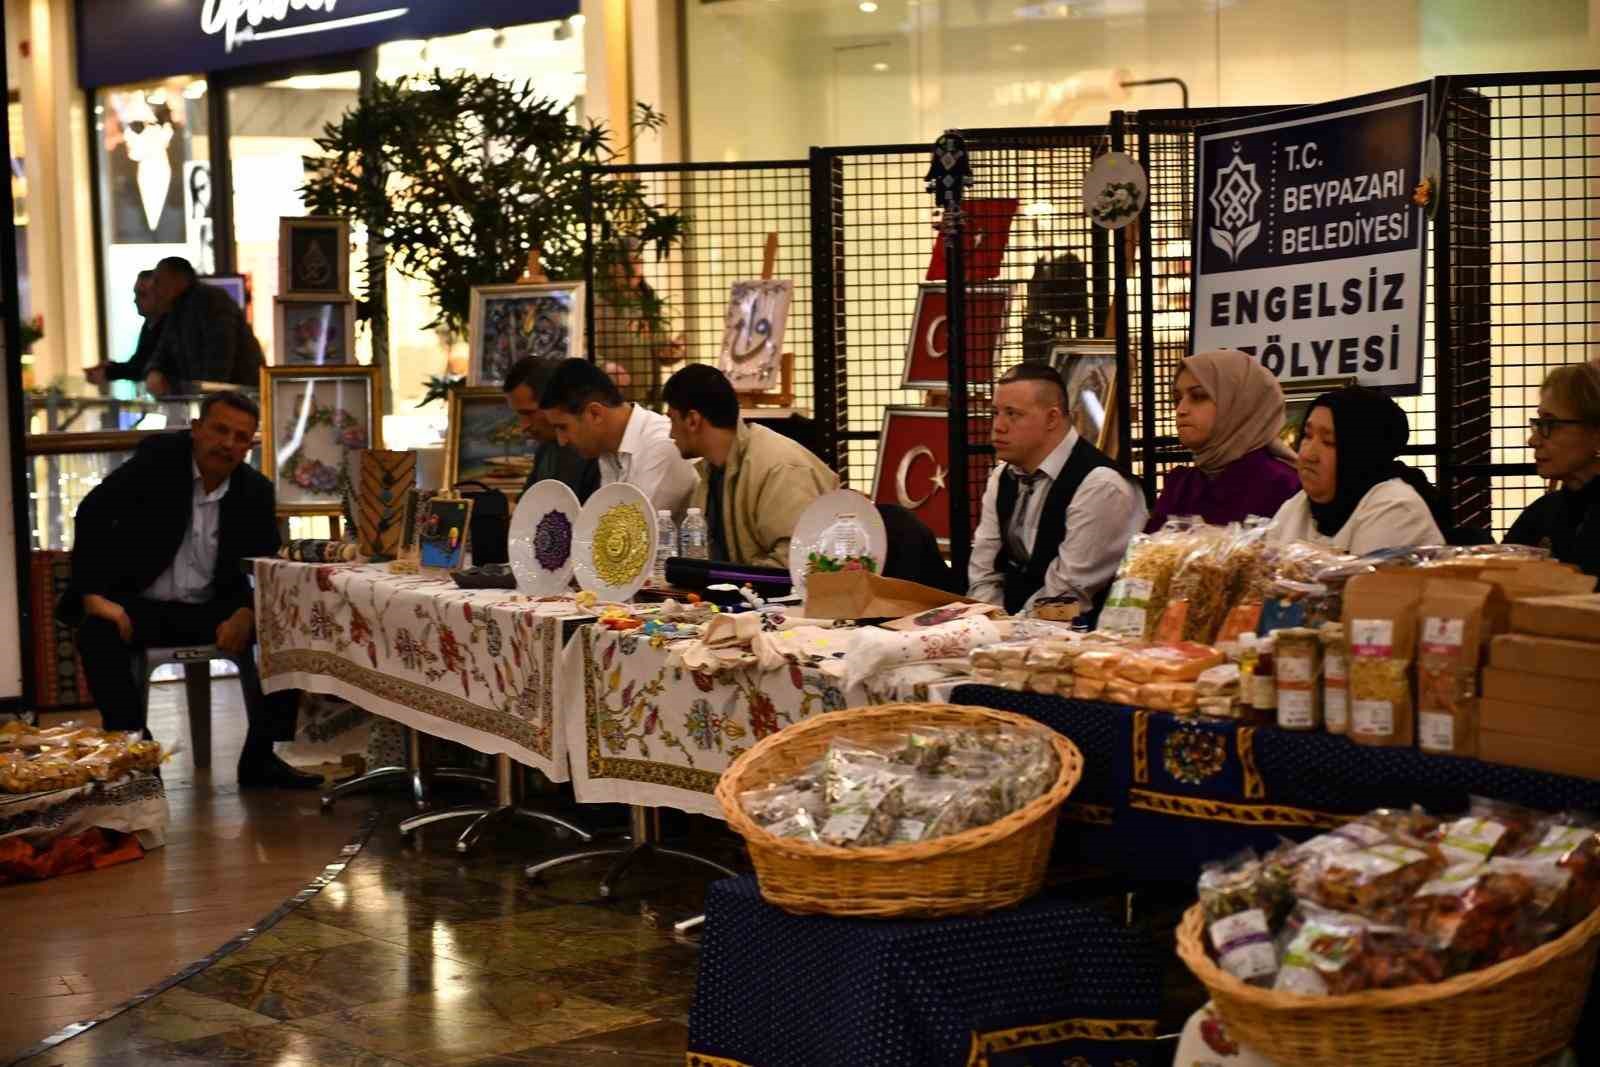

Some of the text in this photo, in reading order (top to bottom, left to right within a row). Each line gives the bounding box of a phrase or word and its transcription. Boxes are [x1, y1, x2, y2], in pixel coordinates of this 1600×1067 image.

[1284, 142, 1324, 172] T.C.
[1283, 168, 1405, 213] BEYPAZARI
[1282, 204, 1409, 255] BELEDİYESİ
[1210, 267, 1405, 327] ENGELSİZ
[1218, 324, 1400, 377] ÖLYESİ
